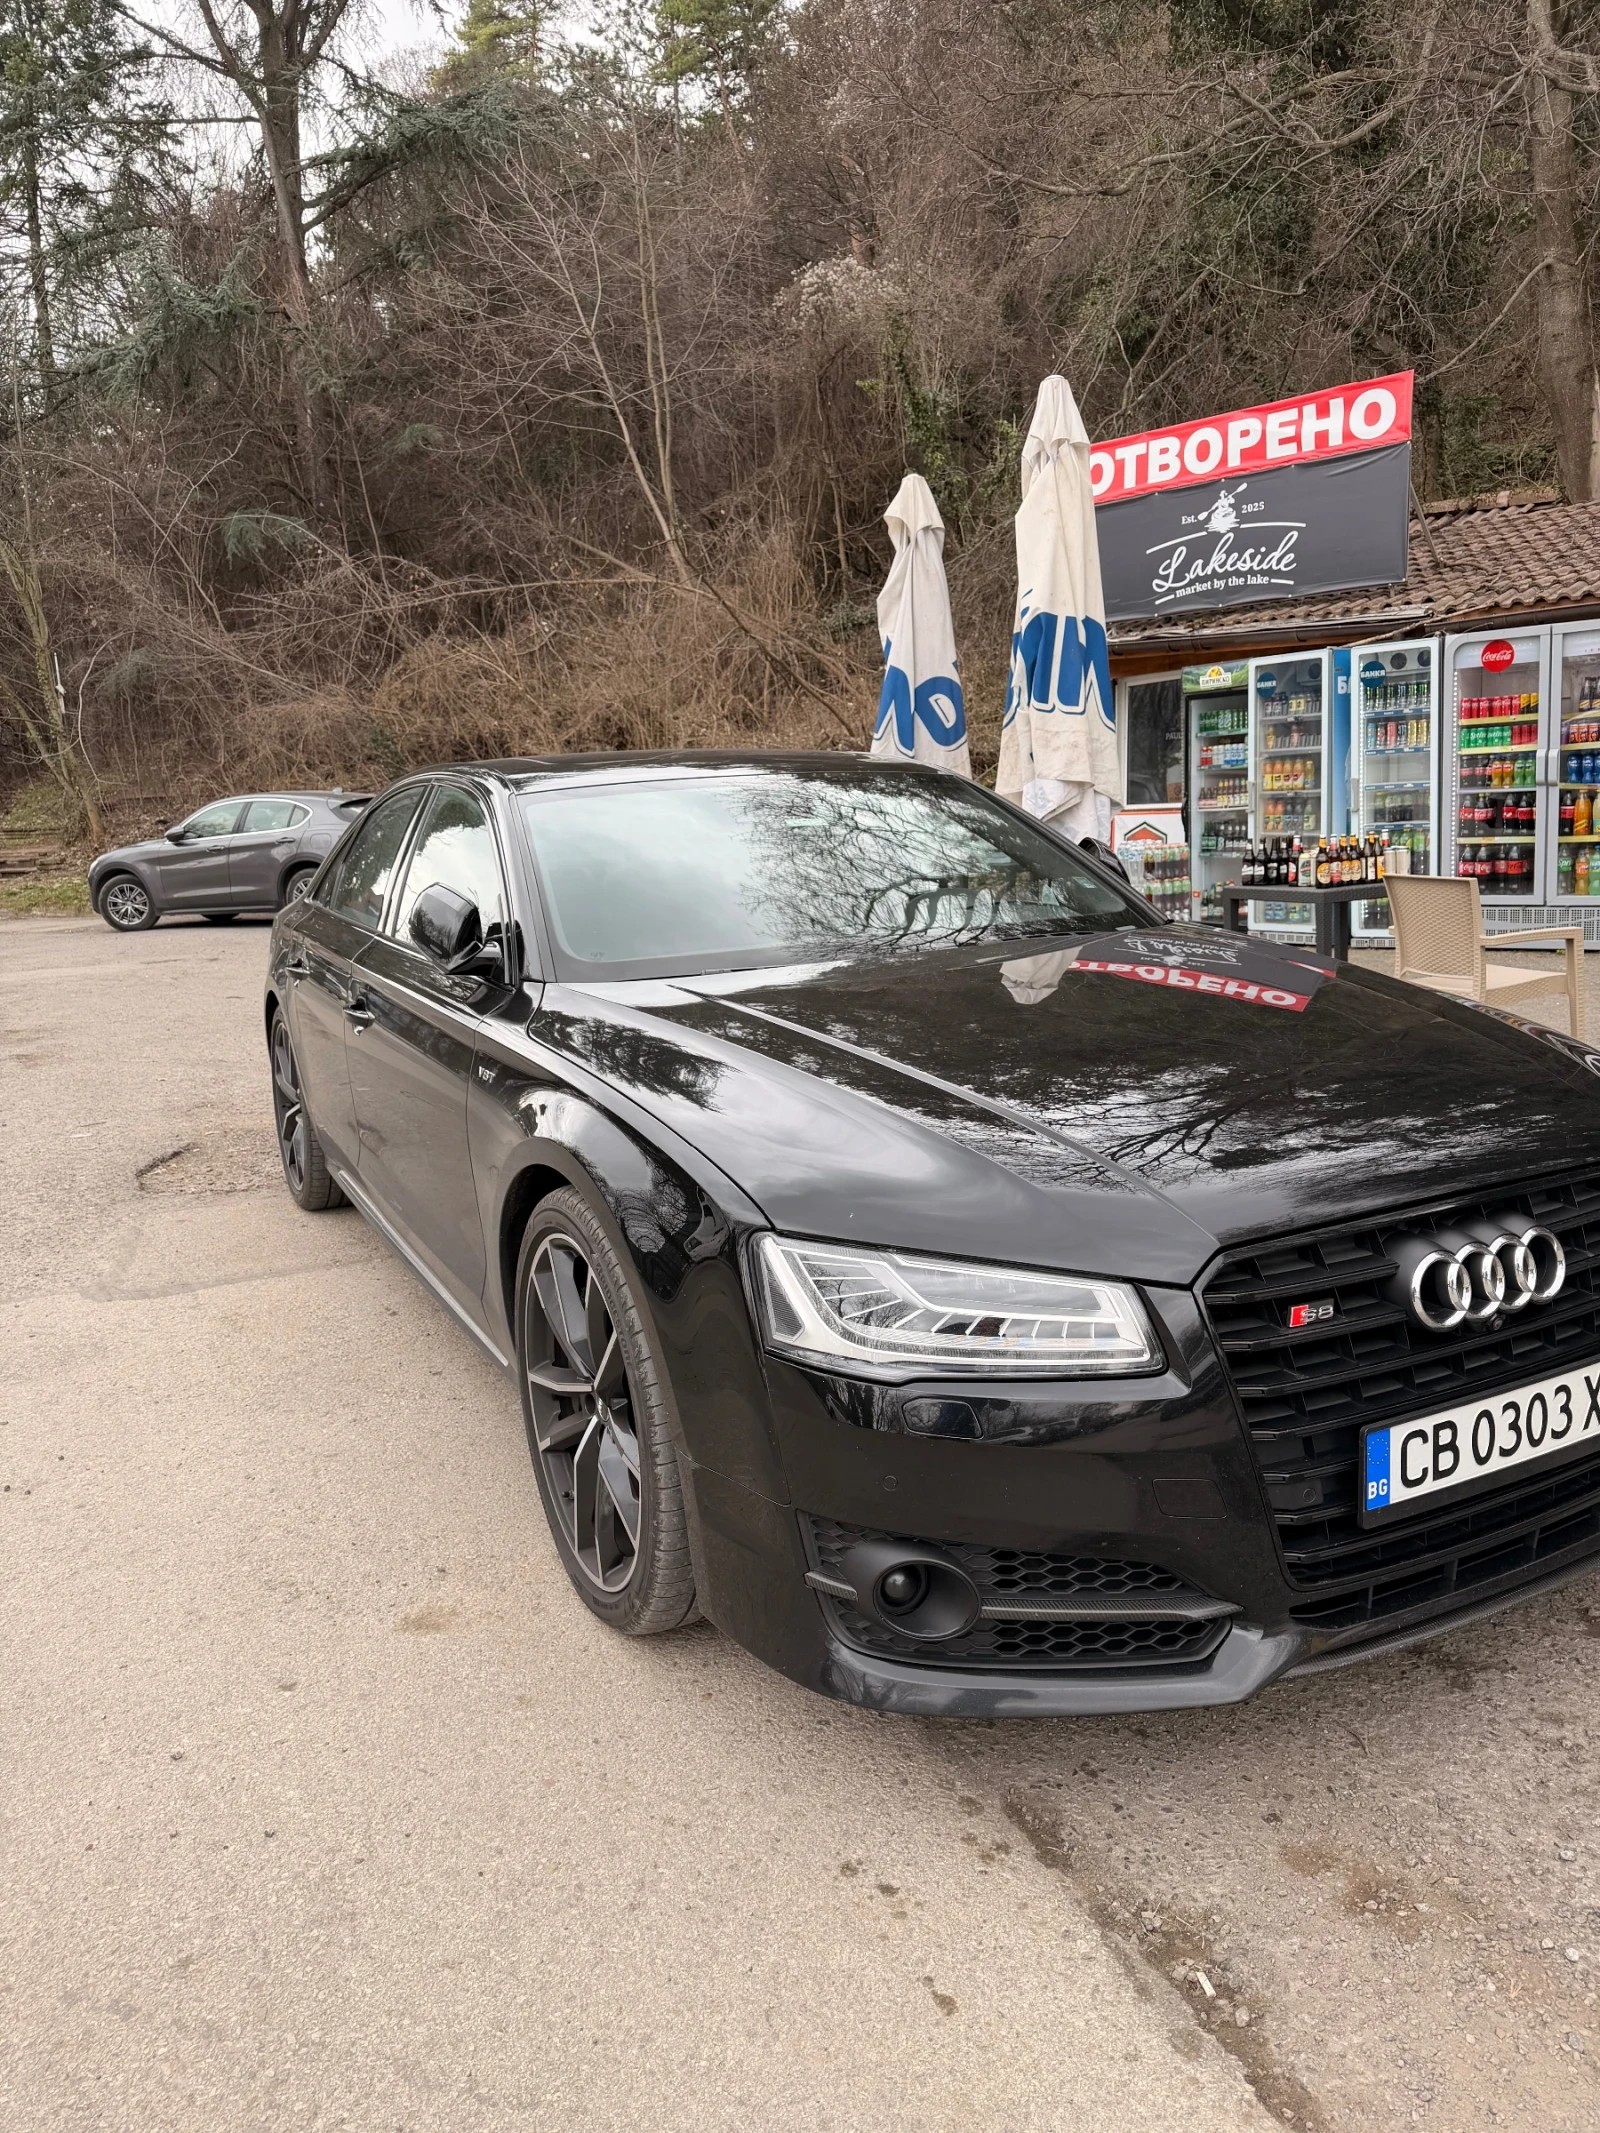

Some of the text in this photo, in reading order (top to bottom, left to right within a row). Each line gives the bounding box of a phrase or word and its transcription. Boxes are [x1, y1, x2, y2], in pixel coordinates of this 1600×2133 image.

[1090, 388, 1397, 497] ОТВОРЕНО
[1181, 501, 1265, 525] Est. 2025
[1152, 530, 1297, 593] Lakeside
[1175, 573, 1270, 598] market by the lake
[1257, 680, 1277, 688] БАНКЯ
[1360, 669, 1385, 678] БАНКЯ
[1337, 676, 1351, 694] Б
[1302, 1304, 1334, 1322] S8
[1400, 1421, 1460, 1489] CB
[1471, 1384, 1574, 1466] 0303
[1367, 1479, 1389, 1499] BG
